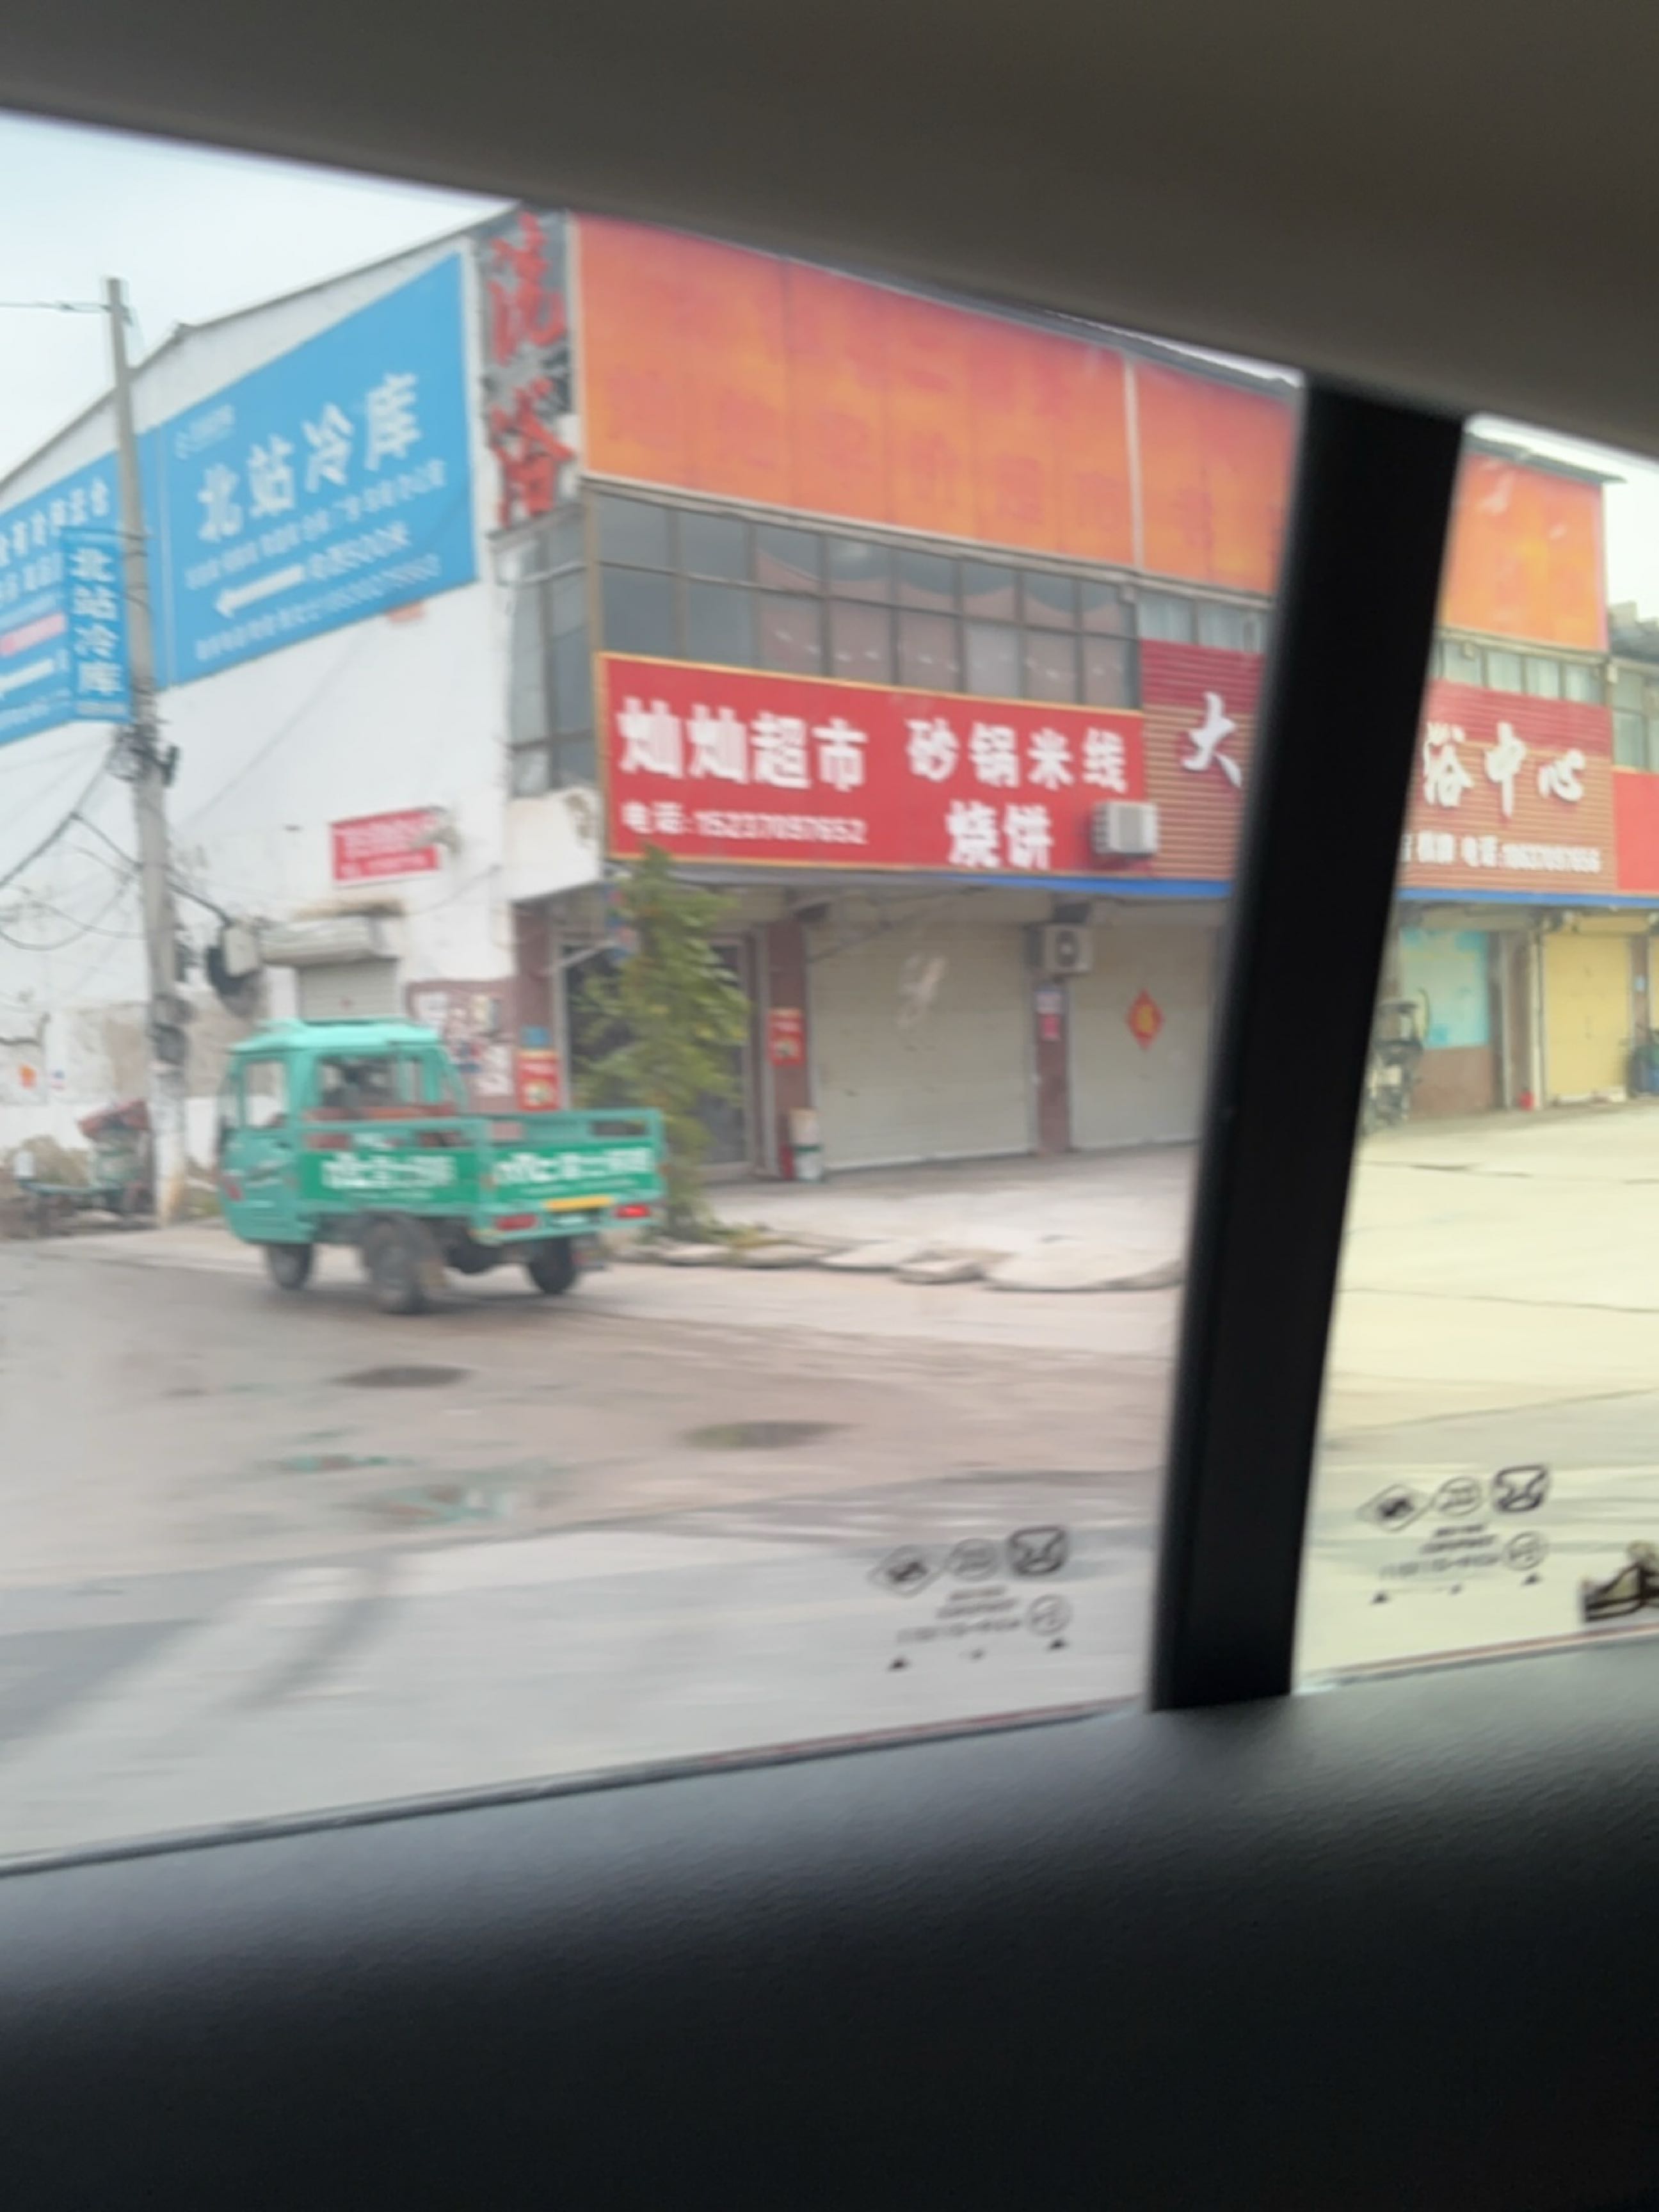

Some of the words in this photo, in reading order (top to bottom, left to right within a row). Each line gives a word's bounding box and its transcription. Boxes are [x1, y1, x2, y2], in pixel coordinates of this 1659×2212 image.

[197, 373, 422, 543] 北站冷库
[68, 547, 124, 698] 北站冷库
[616, 696, 868, 793] 灿灿超市
[905, 717, 1129, 794] 砂锅米线
[946, 799, 1052, 870] 烧饼
